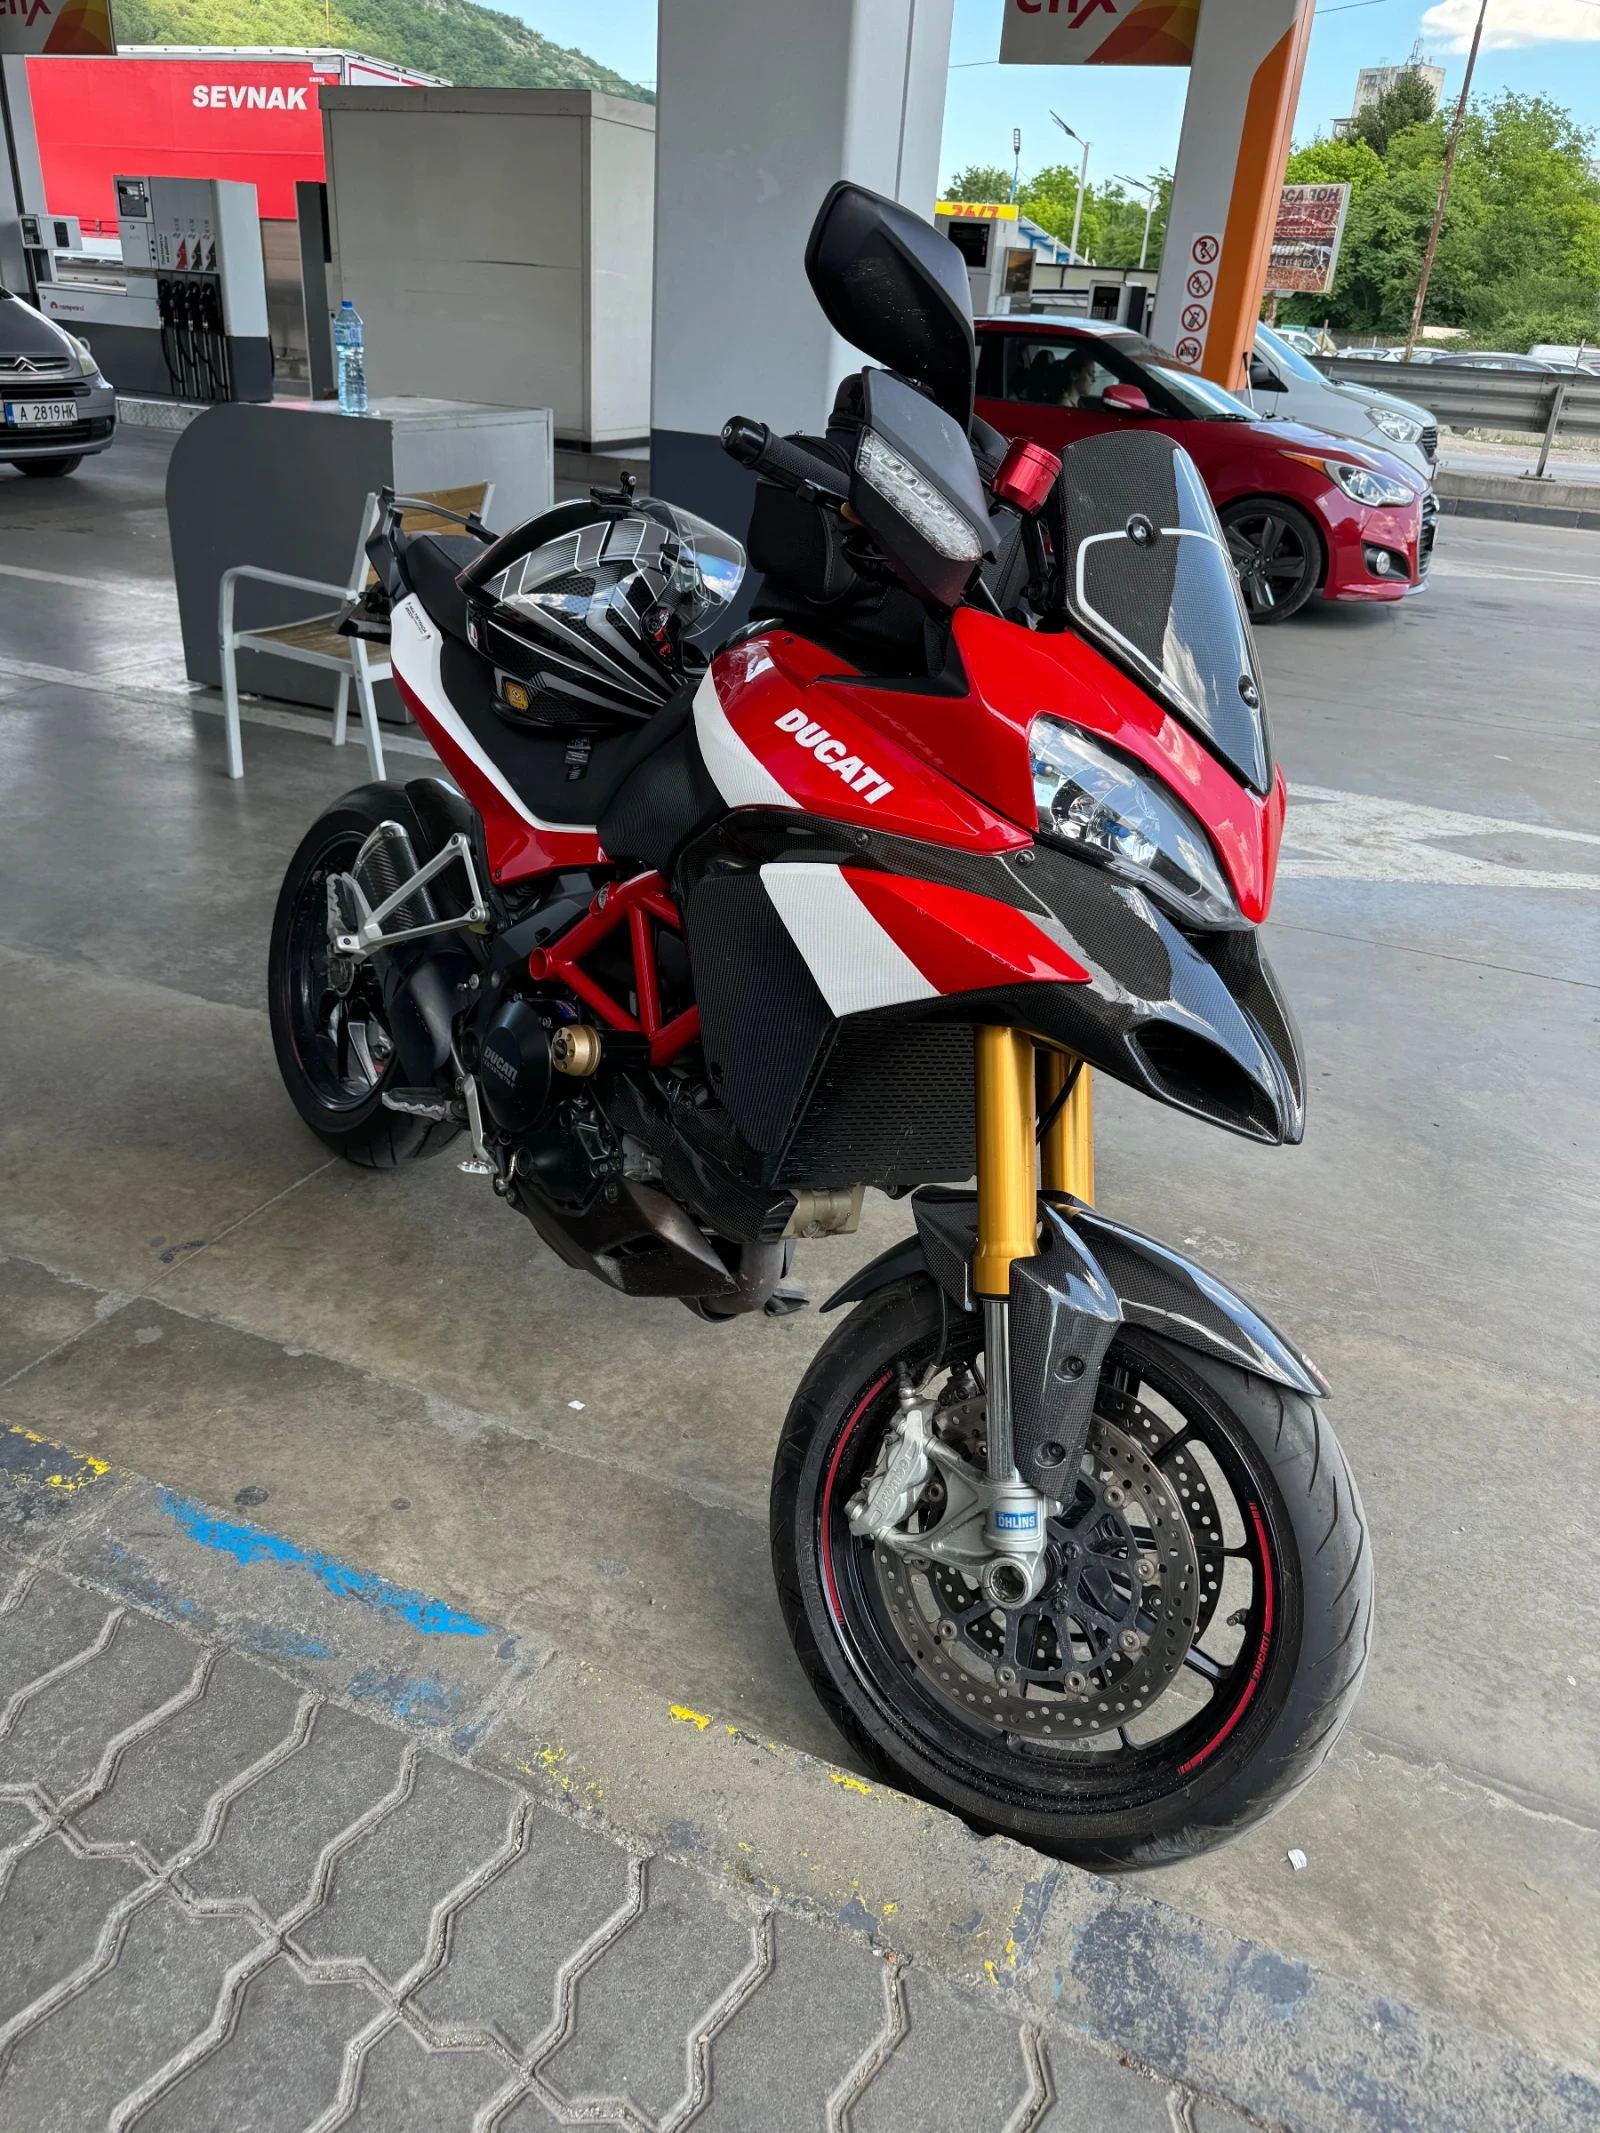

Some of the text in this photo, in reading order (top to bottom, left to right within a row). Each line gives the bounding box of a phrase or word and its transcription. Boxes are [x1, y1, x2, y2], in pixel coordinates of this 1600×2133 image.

[192, 84, 308, 110] SEVNAK
[20, 404, 76, 420] A 2819 HK
[774, 708, 895, 805] DUCATI
[483, 1045, 519, 1082] DUCATI
[874, 1456, 909, 1512] brembo
[997, 1511, 1035, 1528] ÖHLINS
[1253, 1636, 1271, 1680] DUCATI
